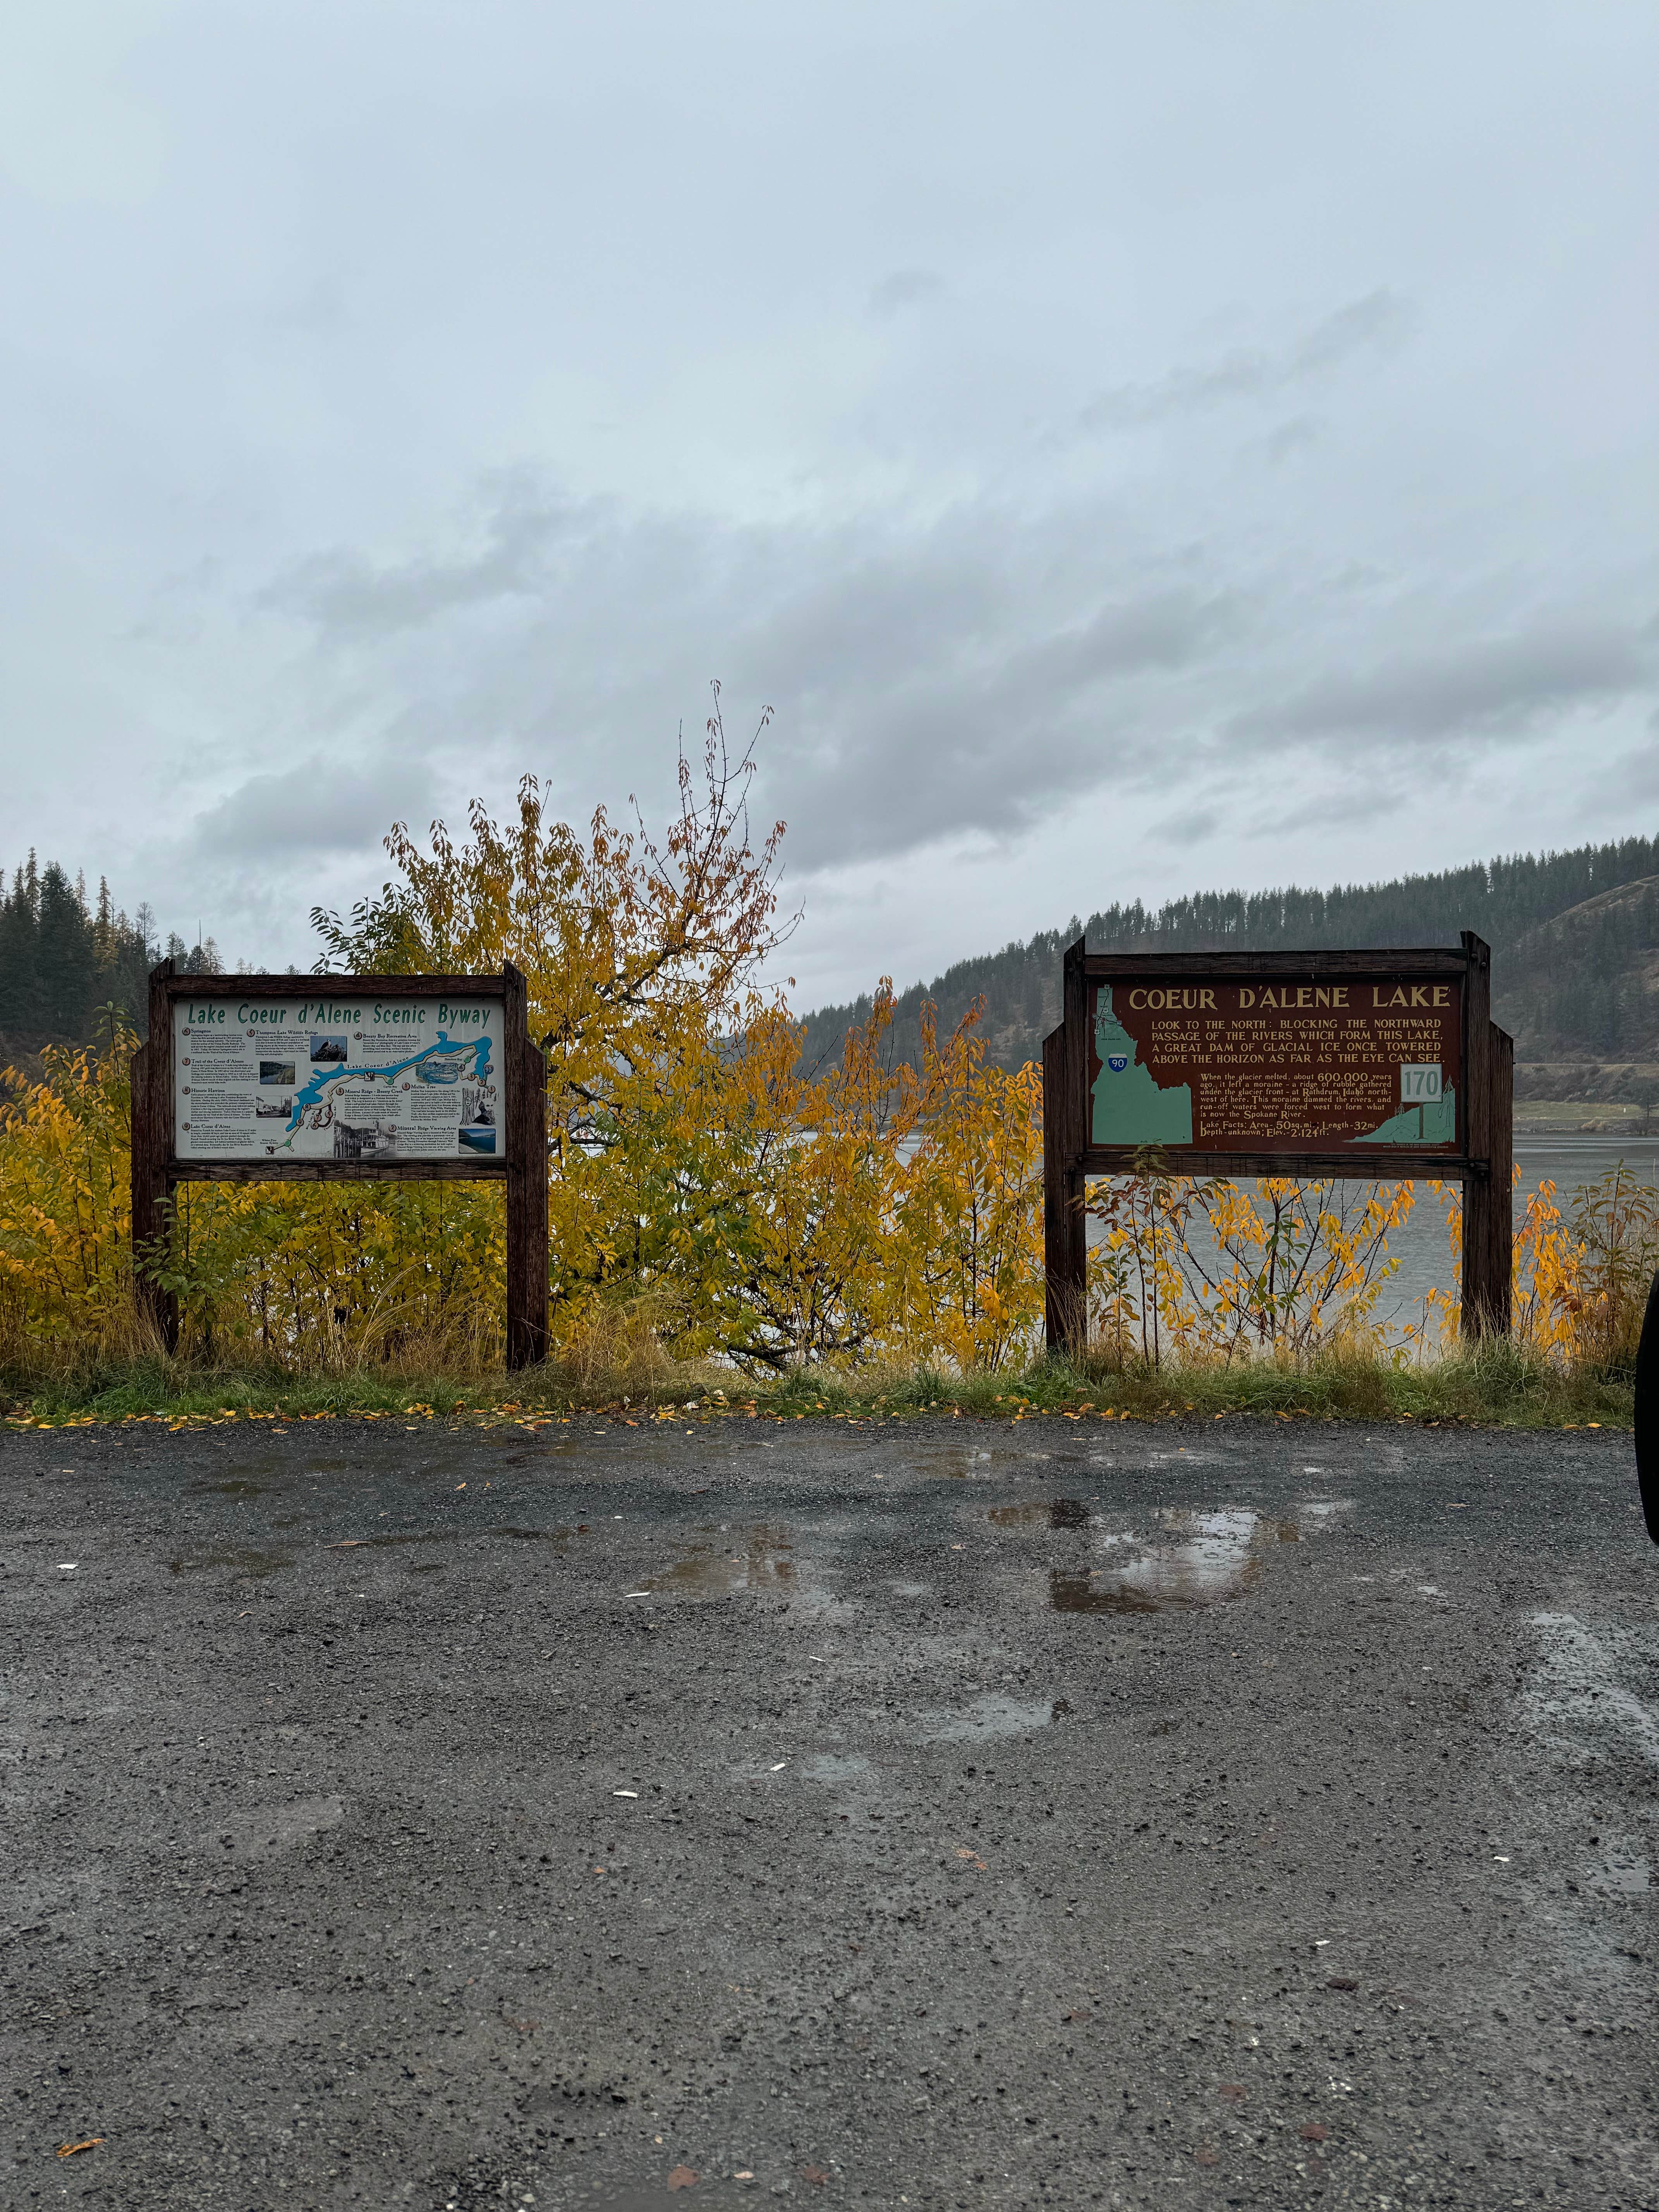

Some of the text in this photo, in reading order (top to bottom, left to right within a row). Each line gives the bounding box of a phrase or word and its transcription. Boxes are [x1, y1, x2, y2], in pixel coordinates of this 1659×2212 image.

[1130, 986, 1449, 1010] COEUR D'ALENE LAKE
[189, 1003, 491, 1029] Lake Coeur d'Alene Scenic Byway
[1152, 1021, 1180, 1029] LOOK
[1186, 1021, 1199, 1029] TO
[1205, 1020, 1225, 1029] THE
[1281, 1019, 1337, 1028] BLOCKING
[1346, 1020, 1367, 1028] THE
[1374, 1019, 1441, 1028] NORTHWARD
[1152, 1030, 1443, 1041] PASSAGE OF THE RIVERS WHICH FORM THIS LAKE,
[1152, 1042, 1441, 1052] A GREAT DAM OF GLACIAL ICE ONCE TOWERED
[386, 1056, 409, 1066] d'Alene
[1112, 1059, 1124, 1067] 90
[1152, 1055, 1188, 1063] ABOVE
[1192, 1055, 1212, 1063] THE
[1217, 1054, 1264, 1063] HORIZON
[1269, 1054, 1284, 1063] AS
[1291, 1054, 1311, 1063] FAR
[1317, 1054, 1332, 1062] AS
[1338, 1054, 1358, 1062] THE
[1389, 1053, 1411, 1062] CAN
[1418, 1054, 1444, 1062] SEE.
[1200, 1073, 1221, 1082] When
[1238, 1073, 1262, 1082] glacier
[1300, 1082, 1317, 1090] ridge
[1360, 1080, 1391, 1089] gathered
[1405, 1071, 1438, 1096] 170
[1238, 1088, 1263, 1097] glacier
[1343, 1088, 1364, 1097] Idaho
[1252, 1096, 1268, 1104] This
[1244, 1111, 1277, 1119] Spokane
[1281, 1111, 1305, 1119] River.
[1223, 1121, 1246, 1130] Facts:
